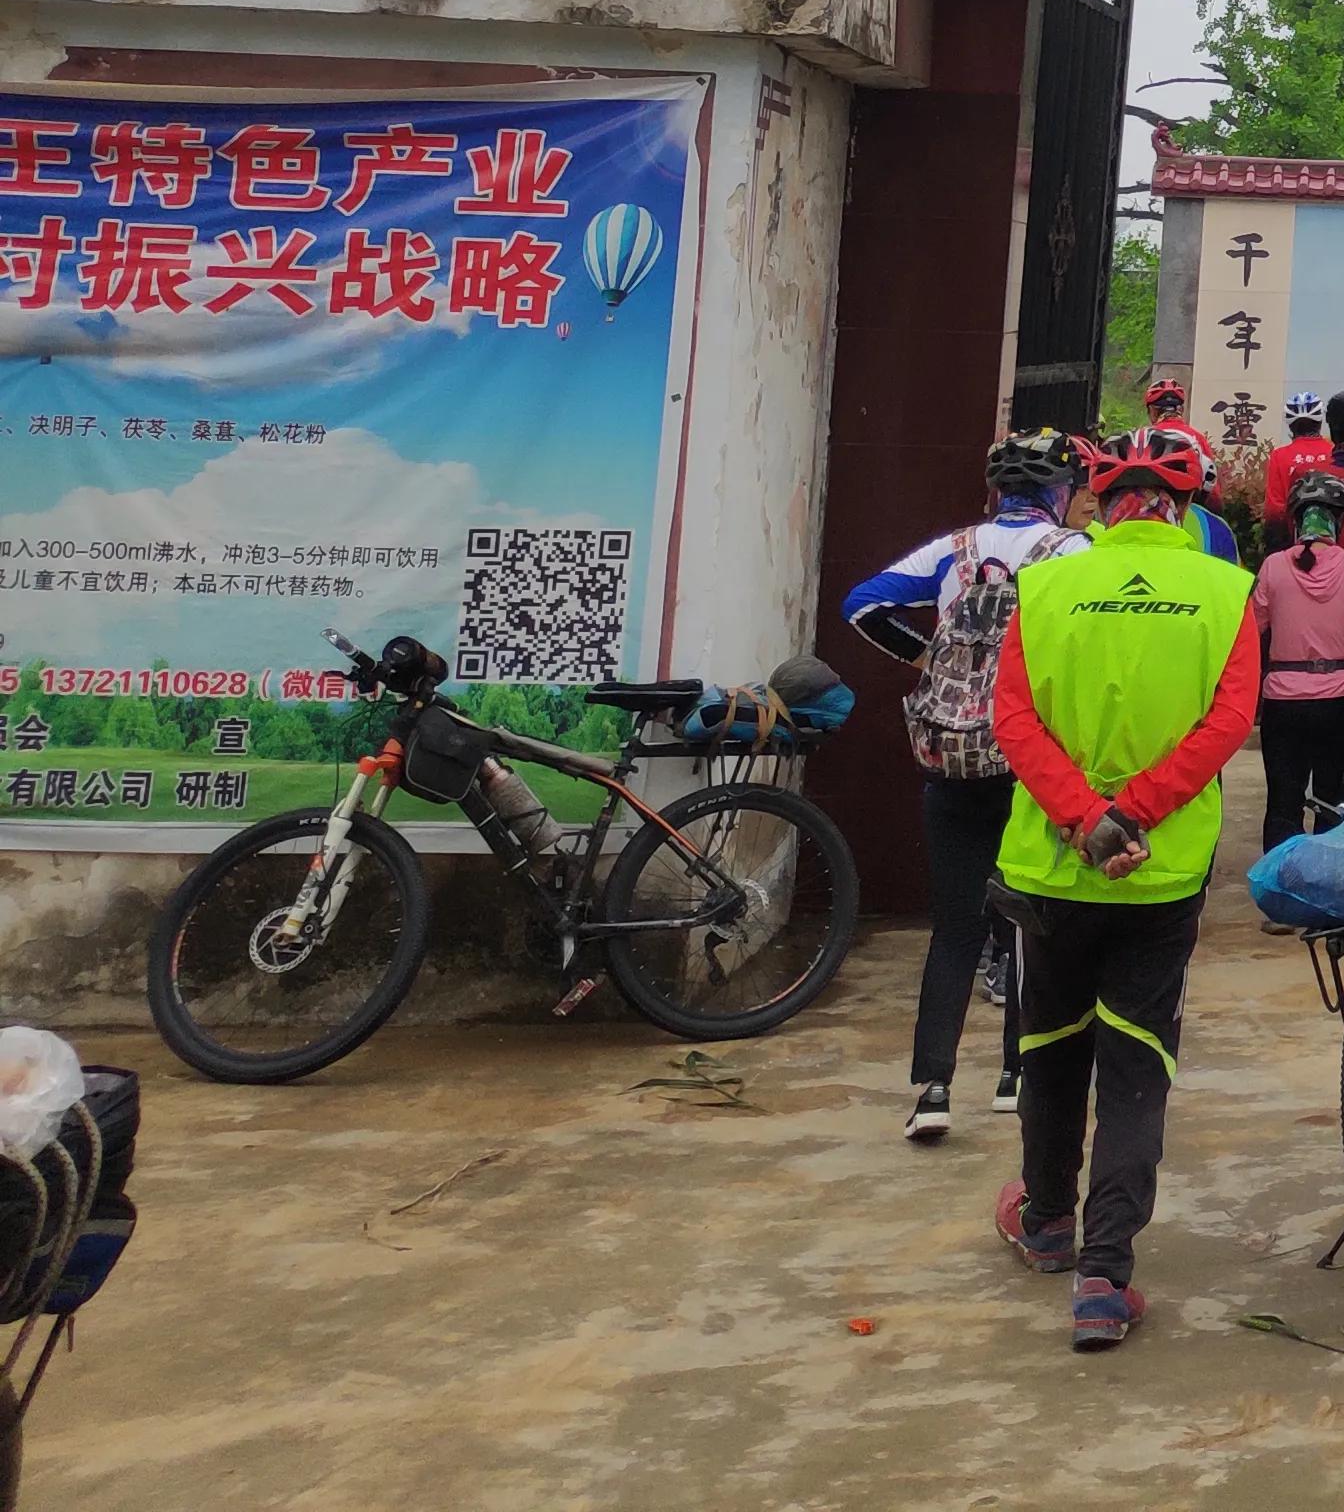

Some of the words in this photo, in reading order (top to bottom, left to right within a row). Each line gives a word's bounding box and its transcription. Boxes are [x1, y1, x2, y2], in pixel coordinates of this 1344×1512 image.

[0, 118, 574, 218] 王特色产业
[0, 414, 327, 445] 、决明子、茯苓、桑葚、松花粉
[1069, 600, 1201, 617] MERIDA
[0, 714, 49, 751] 会
[213, 716, 249, 754] 宣
[0, 768, 152, 808] 有限公司
[175, 770, 247, 809] 研制
